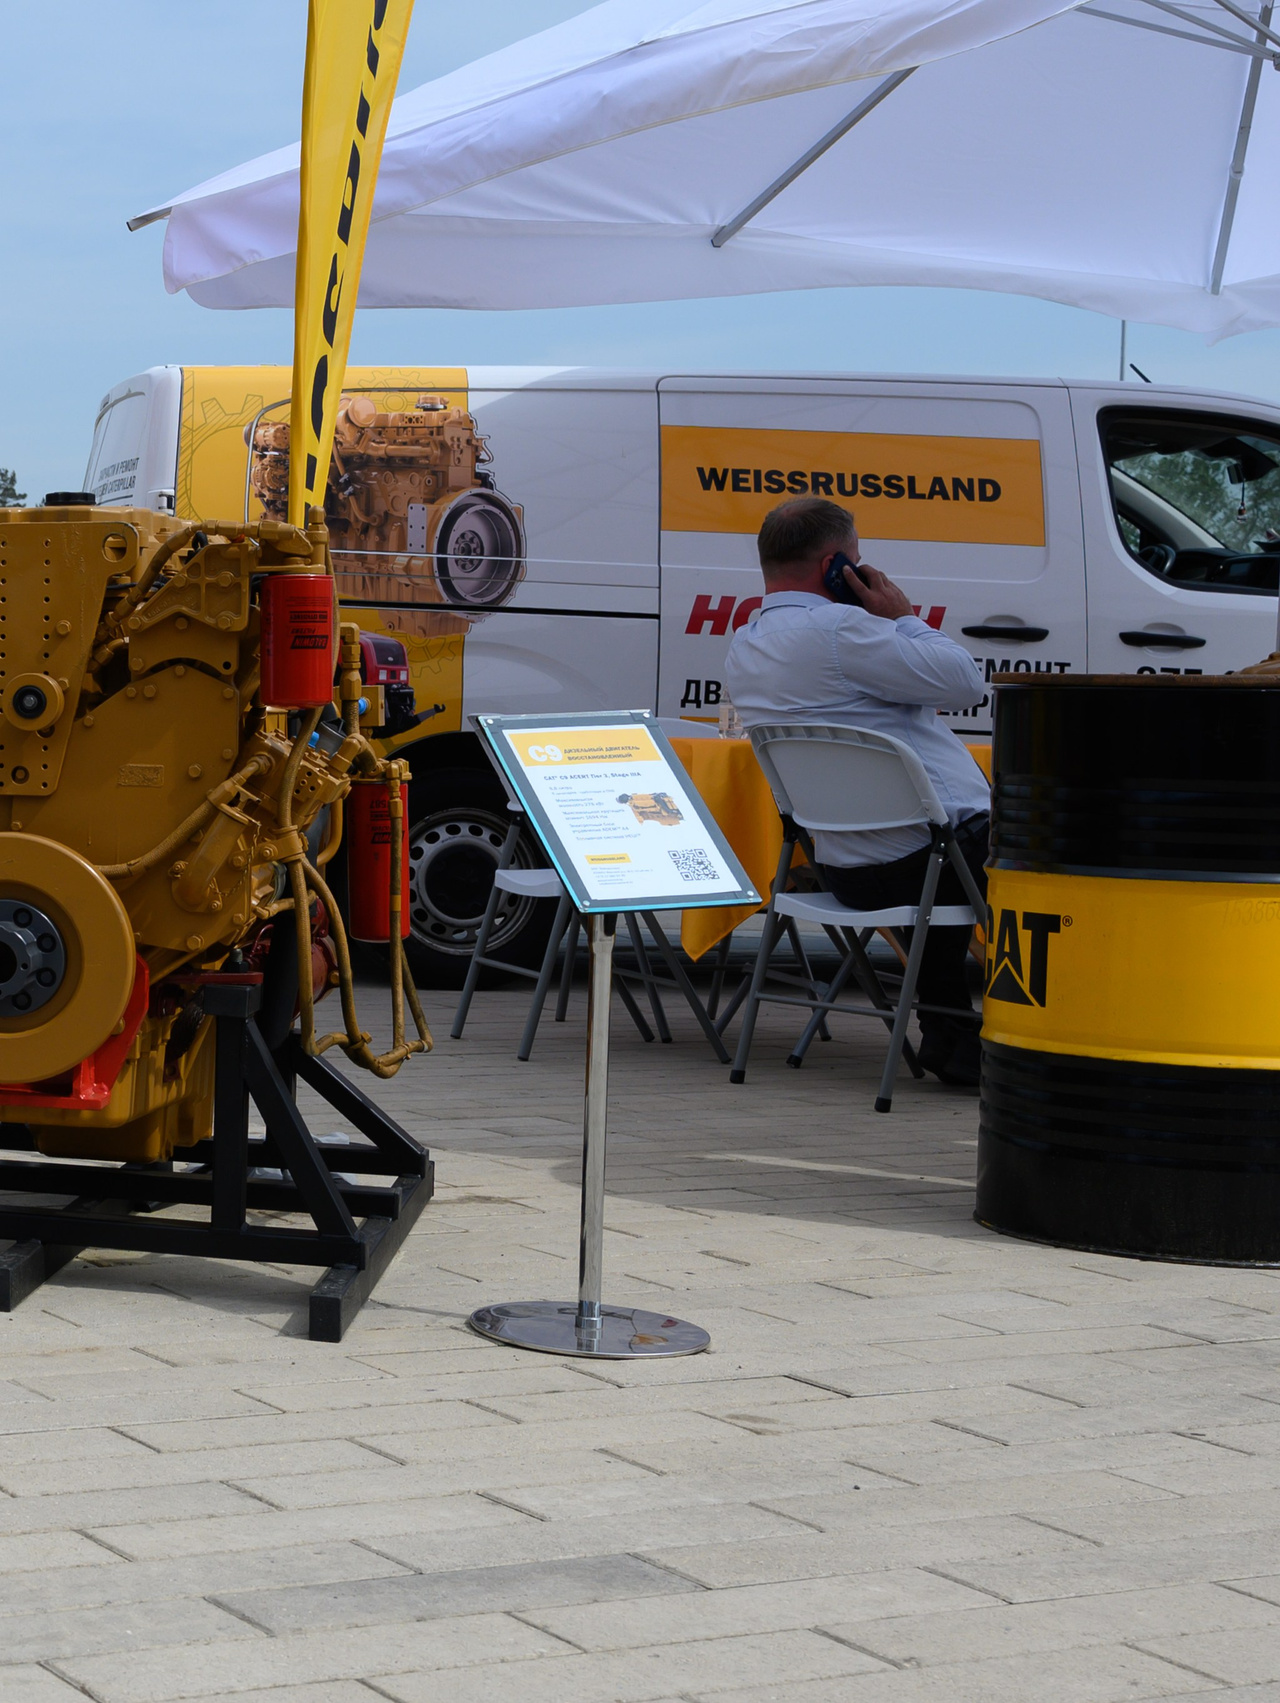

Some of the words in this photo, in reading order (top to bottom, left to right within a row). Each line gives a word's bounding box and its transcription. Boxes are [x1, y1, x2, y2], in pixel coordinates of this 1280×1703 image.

[108, 475, 136, 493] CATERPILLAR
[696, 466, 1001, 502] WEISSRUSSLAND
[528, 744, 563, 762] C9
[563, 746, 604, 754] ДИЗЕЛЬНЫЙ
[567, 753, 633, 761] ВОССТАНОВЛЕННЫЙ
